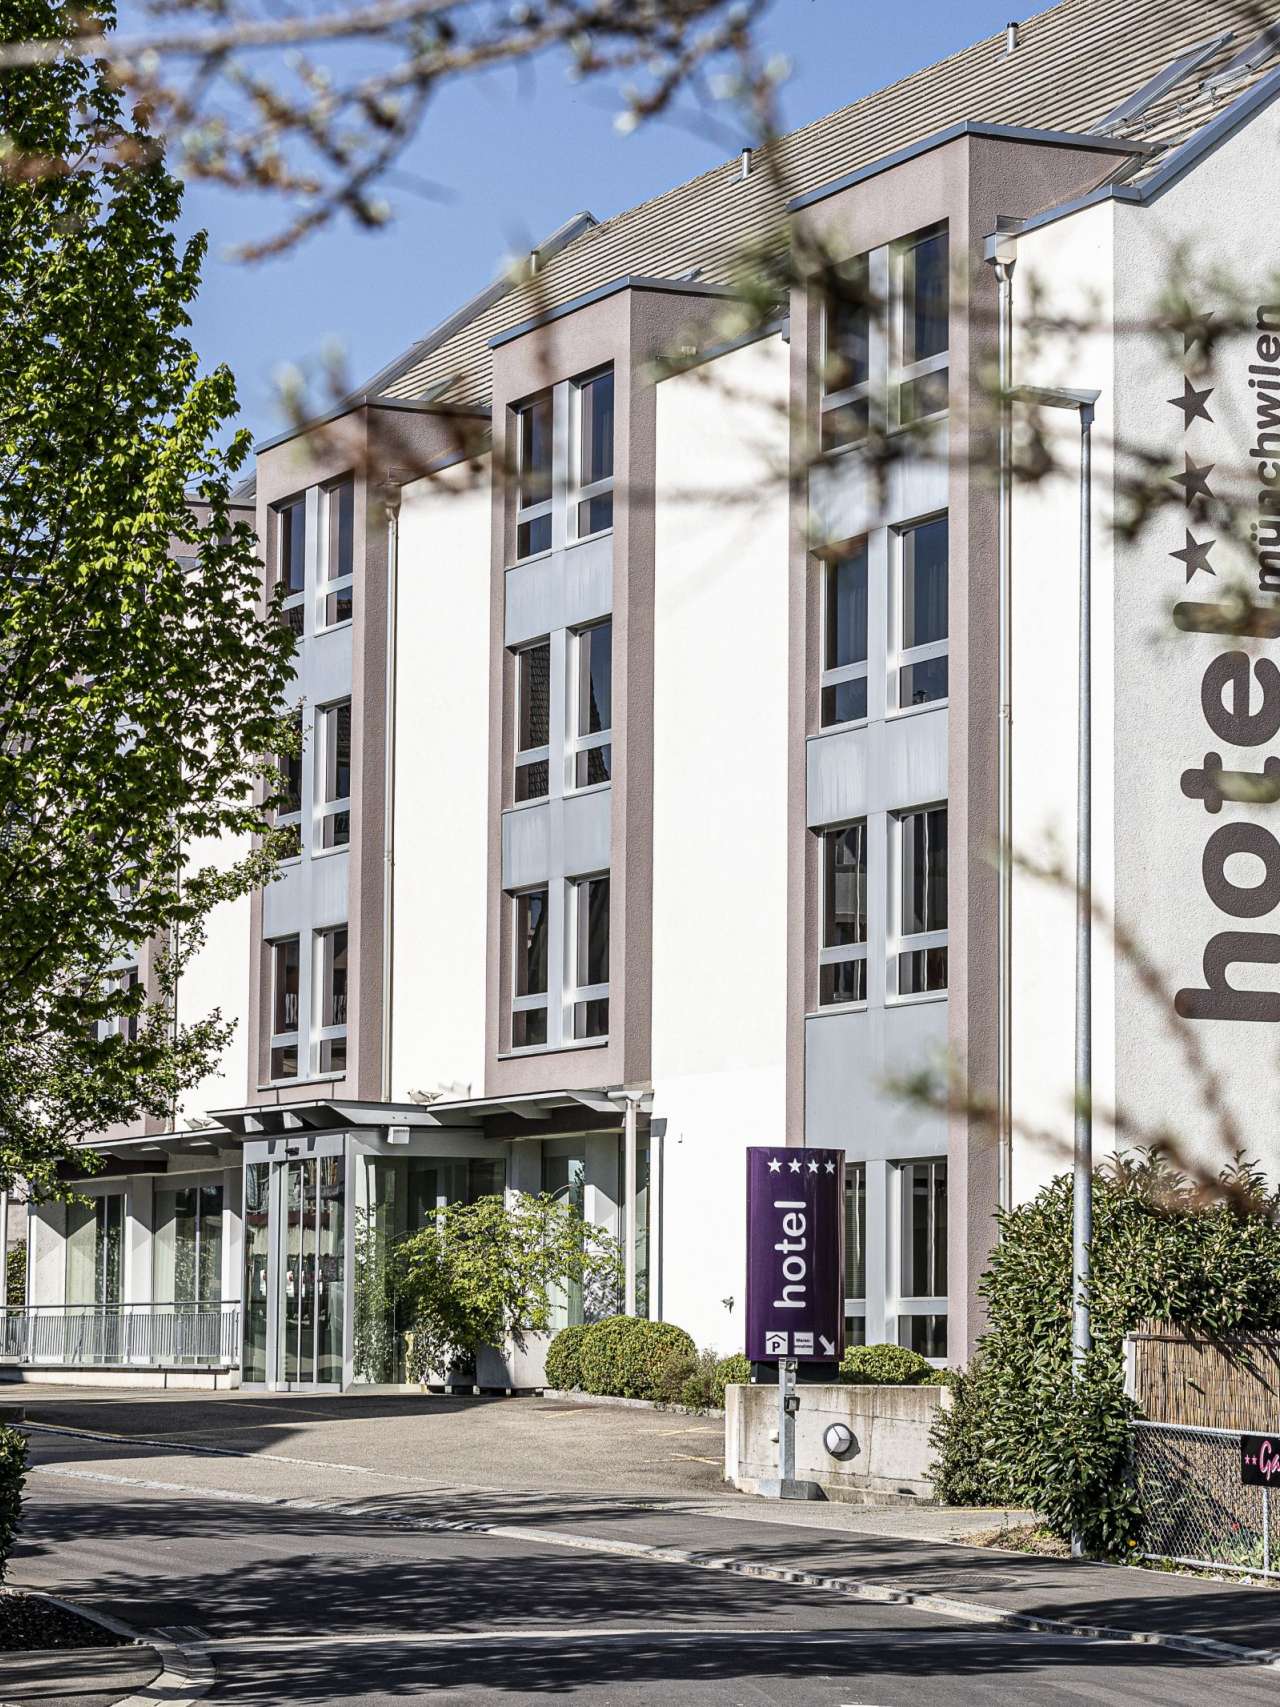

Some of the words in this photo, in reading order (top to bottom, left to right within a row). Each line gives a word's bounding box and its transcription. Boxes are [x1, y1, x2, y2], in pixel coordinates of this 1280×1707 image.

[1173, 601, 1280, 1023] hotel
[1248, 305, 1280, 592] münchwilen
[773, 1201, 806, 1308] hotel
